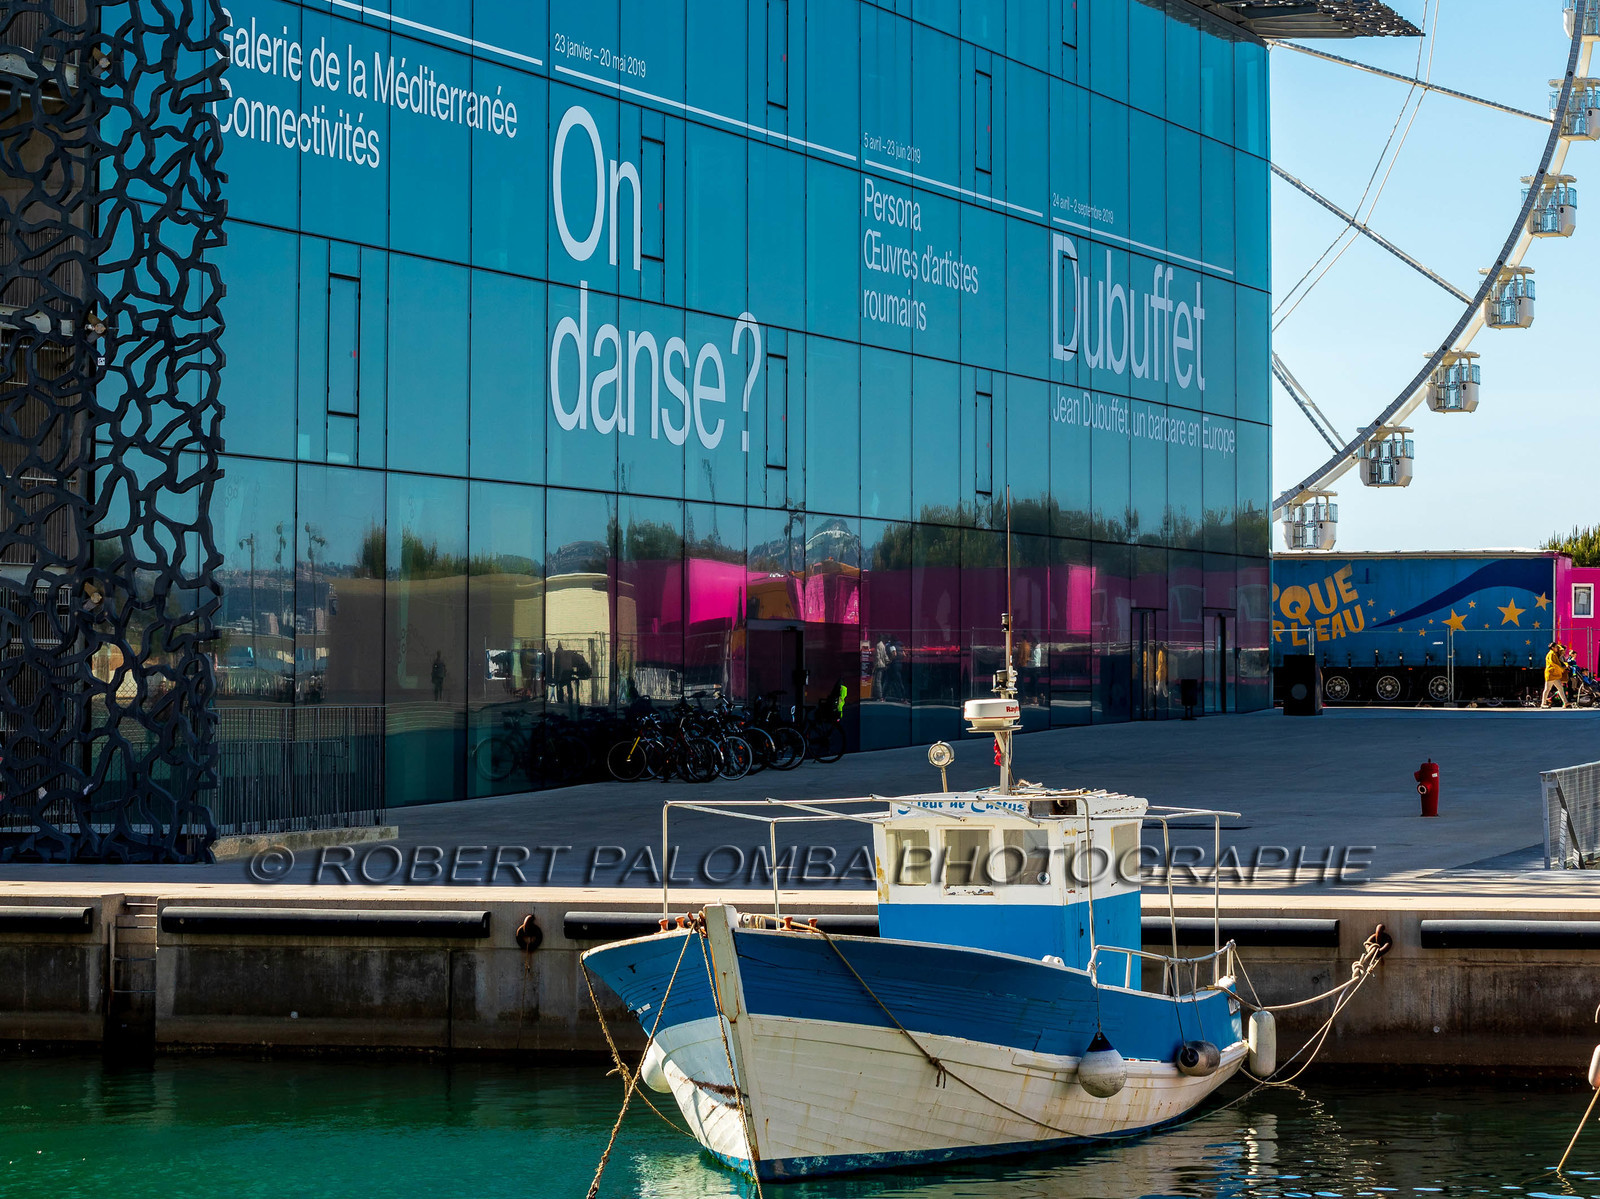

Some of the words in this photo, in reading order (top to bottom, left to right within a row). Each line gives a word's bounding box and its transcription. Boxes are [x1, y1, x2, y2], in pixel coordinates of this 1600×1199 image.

[214, 7, 302, 82] Galerie
[310, 37, 341, 92] de
[348, 44, 367, 99] la
[374, 52, 517, 138] Méditerranée
[554, 33, 566, 54] 23
[566, 36, 593, 62] janvier
[600, 47, 611, 68] 20
[612, 54, 626, 73] mai
[627, 56, 646, 78] 2019
[211, 78, 380, 168] Connectivités
[863, 132, 869, 148] 5
[869, 136, 882, 152] avril
[887, 139, 896, 156] 23
[896, 141, 907, 160] juin
[907, 145, 921, 164] 2019
[553, 106, 641, 270] On
[864, 178, 921, 232] Persona
[864, 228, 918, 280] Œuvres
[921, 245, 979, 294] d’artistes
[863, 289, 926, 331] roumains
[1052, 232, 1206, 391] Dubuffet
[1053, 386, 1080, 425] Jean
[1083, 391, 1131, 440] Dubuffet,
[1132, 410, 1146, 438] un
[1148, 405, 1186, 445] barbare
[1188, 422, 1200, 447] en
[1202, 417, 1236, 459] Europe
